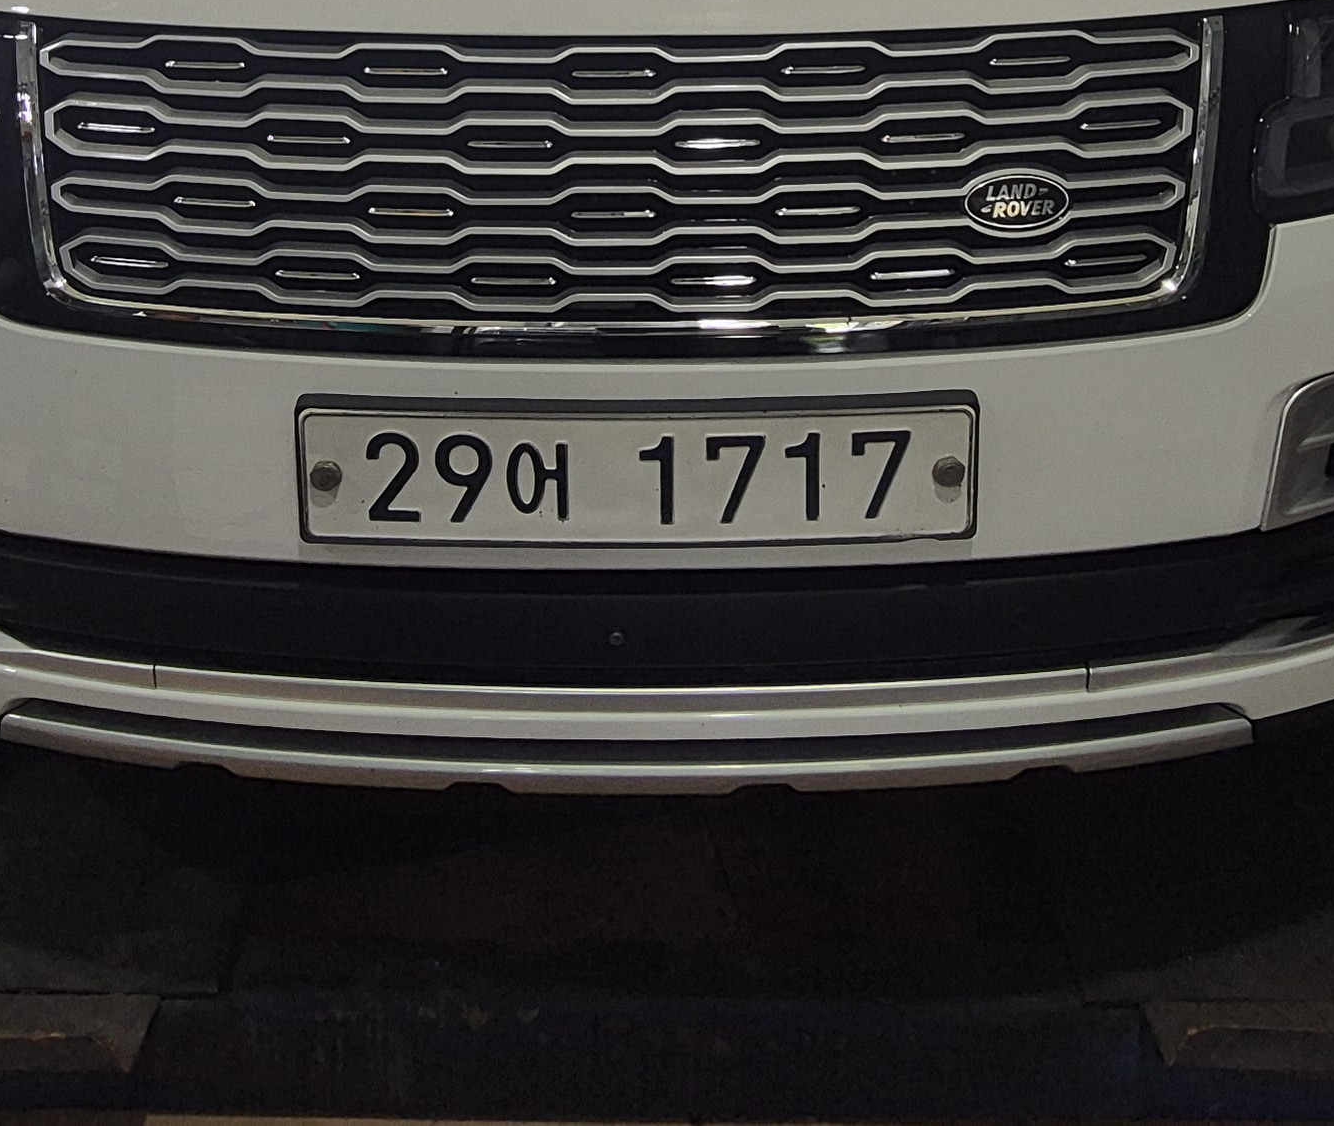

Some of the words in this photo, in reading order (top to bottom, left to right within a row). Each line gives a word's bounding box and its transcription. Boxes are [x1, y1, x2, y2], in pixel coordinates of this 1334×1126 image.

[985, 183, 1038, 202] LAND
[992, 199, 1056, 219] ROVER
[365, 431, 570, 523] 29어
[637, 429, 913, 525] 1717
